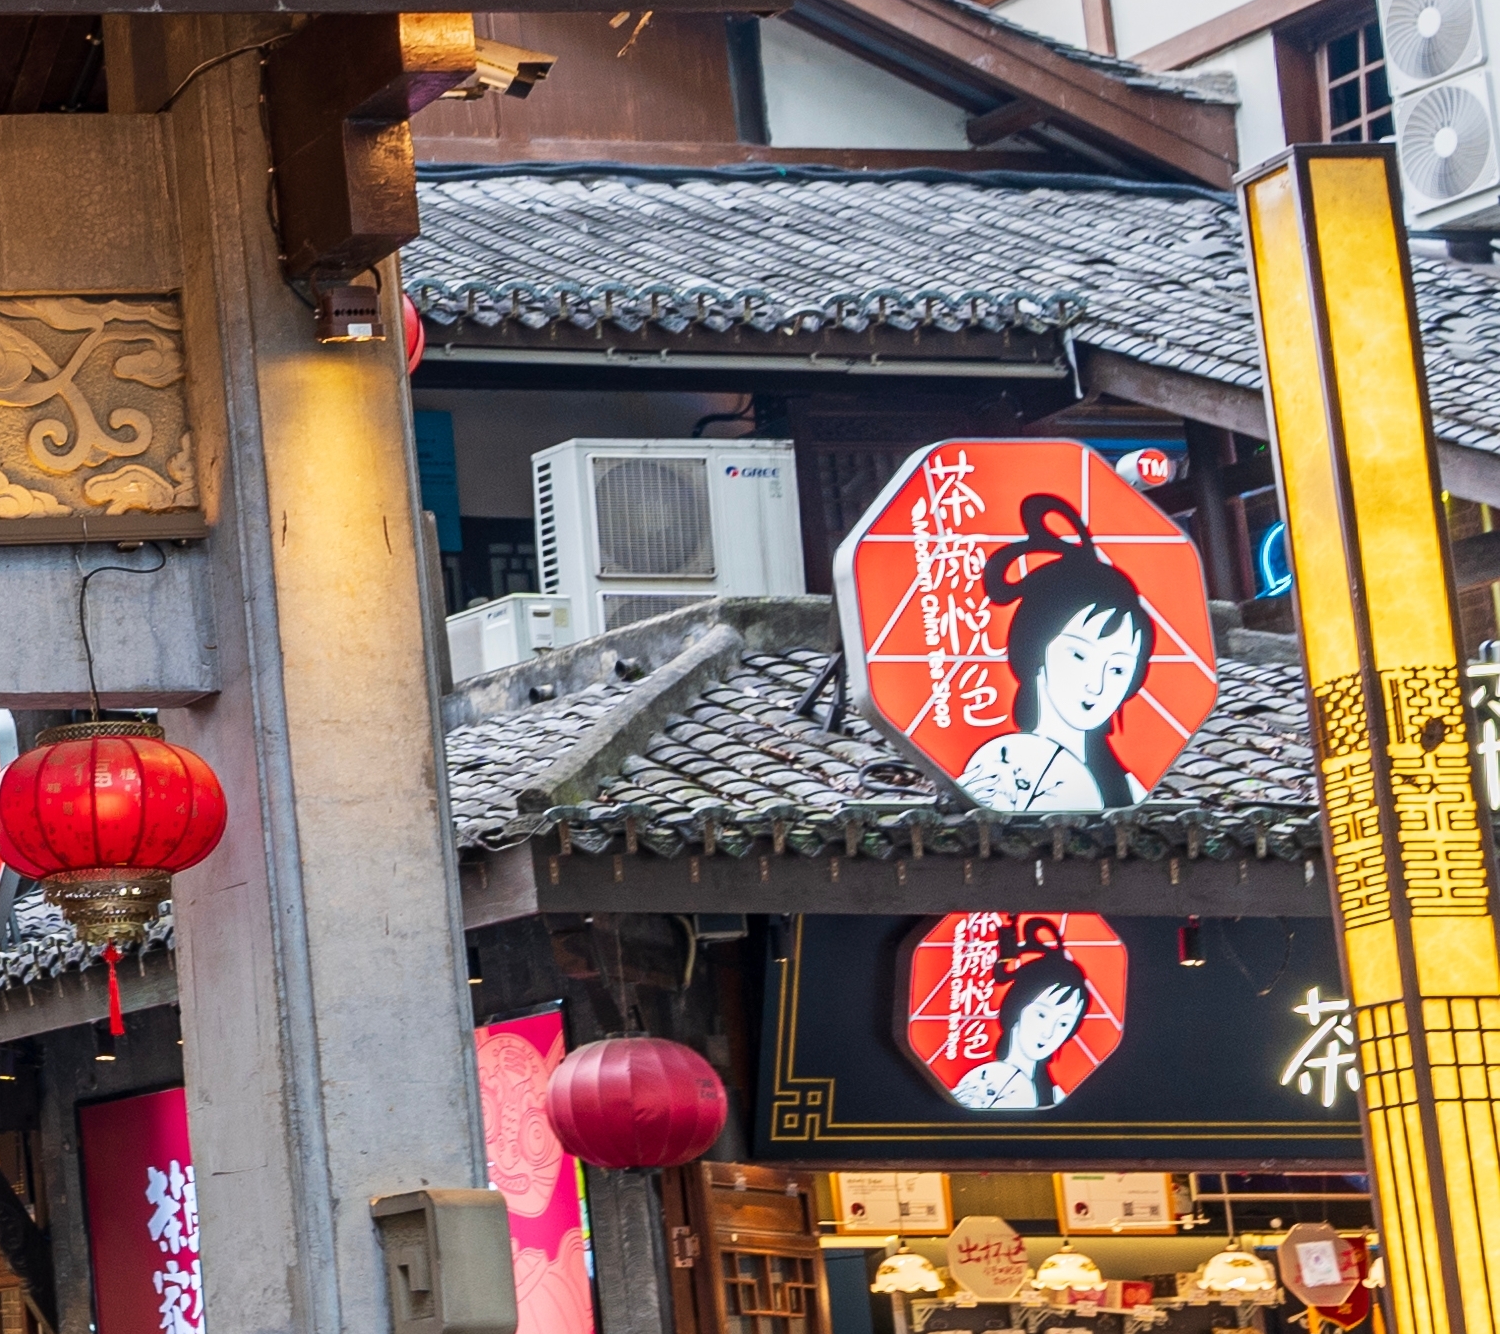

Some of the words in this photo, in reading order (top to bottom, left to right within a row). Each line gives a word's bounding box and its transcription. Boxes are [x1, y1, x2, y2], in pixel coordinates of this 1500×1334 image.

[1138, 458, 1168, 477] TM
[911, 520, 933, 592] Modern
[920, 595, 940, 646] China
[927, 647, 946, 679] Tea
